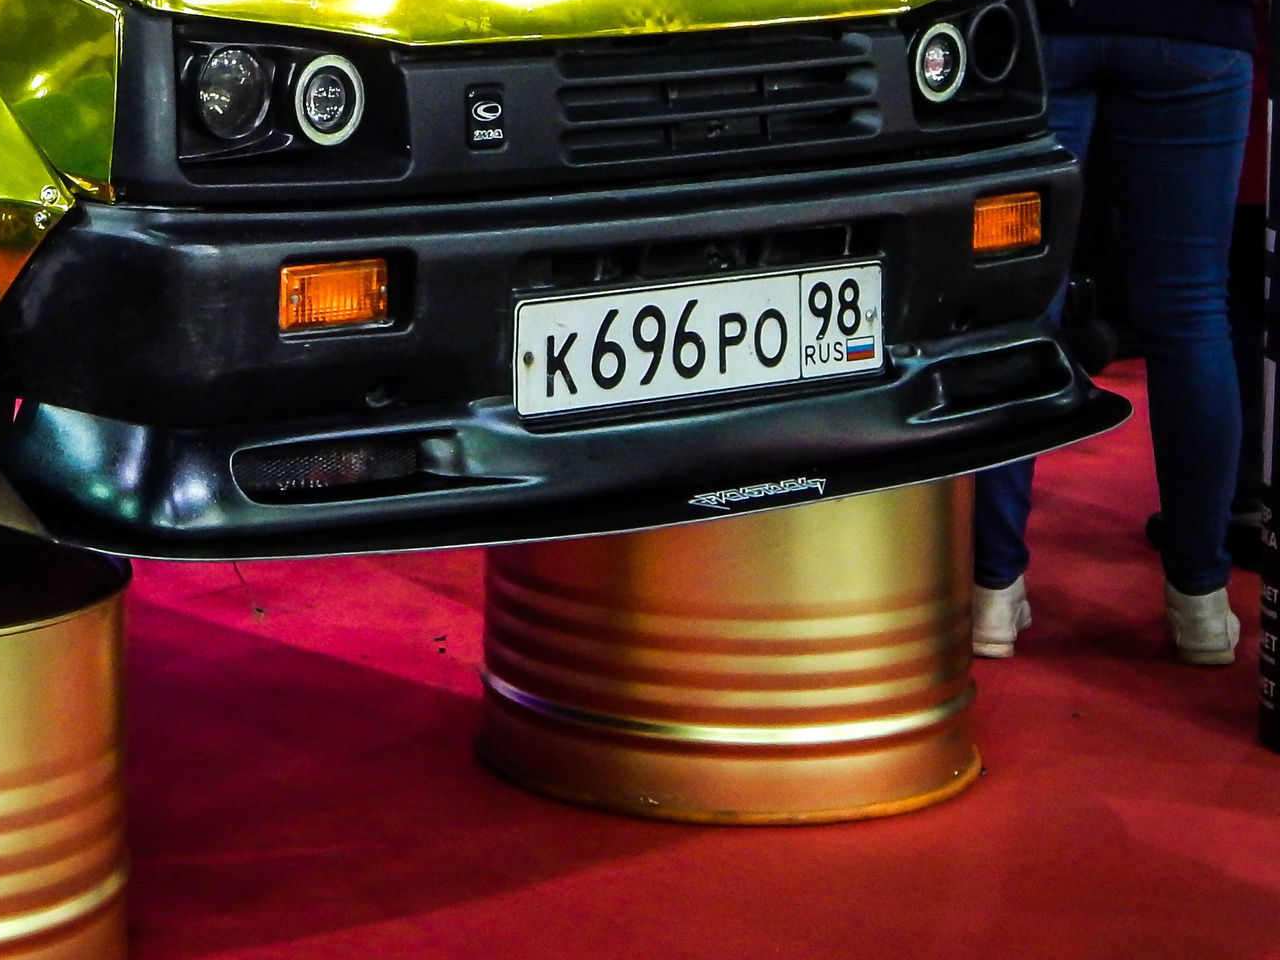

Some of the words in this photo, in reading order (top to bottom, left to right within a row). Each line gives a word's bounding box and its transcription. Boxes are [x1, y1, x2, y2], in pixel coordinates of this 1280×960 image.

[546, 298, 788, 398] К696РО
[808, 277, 862, 340] 98
[804, 340, 845, 366] RUS
